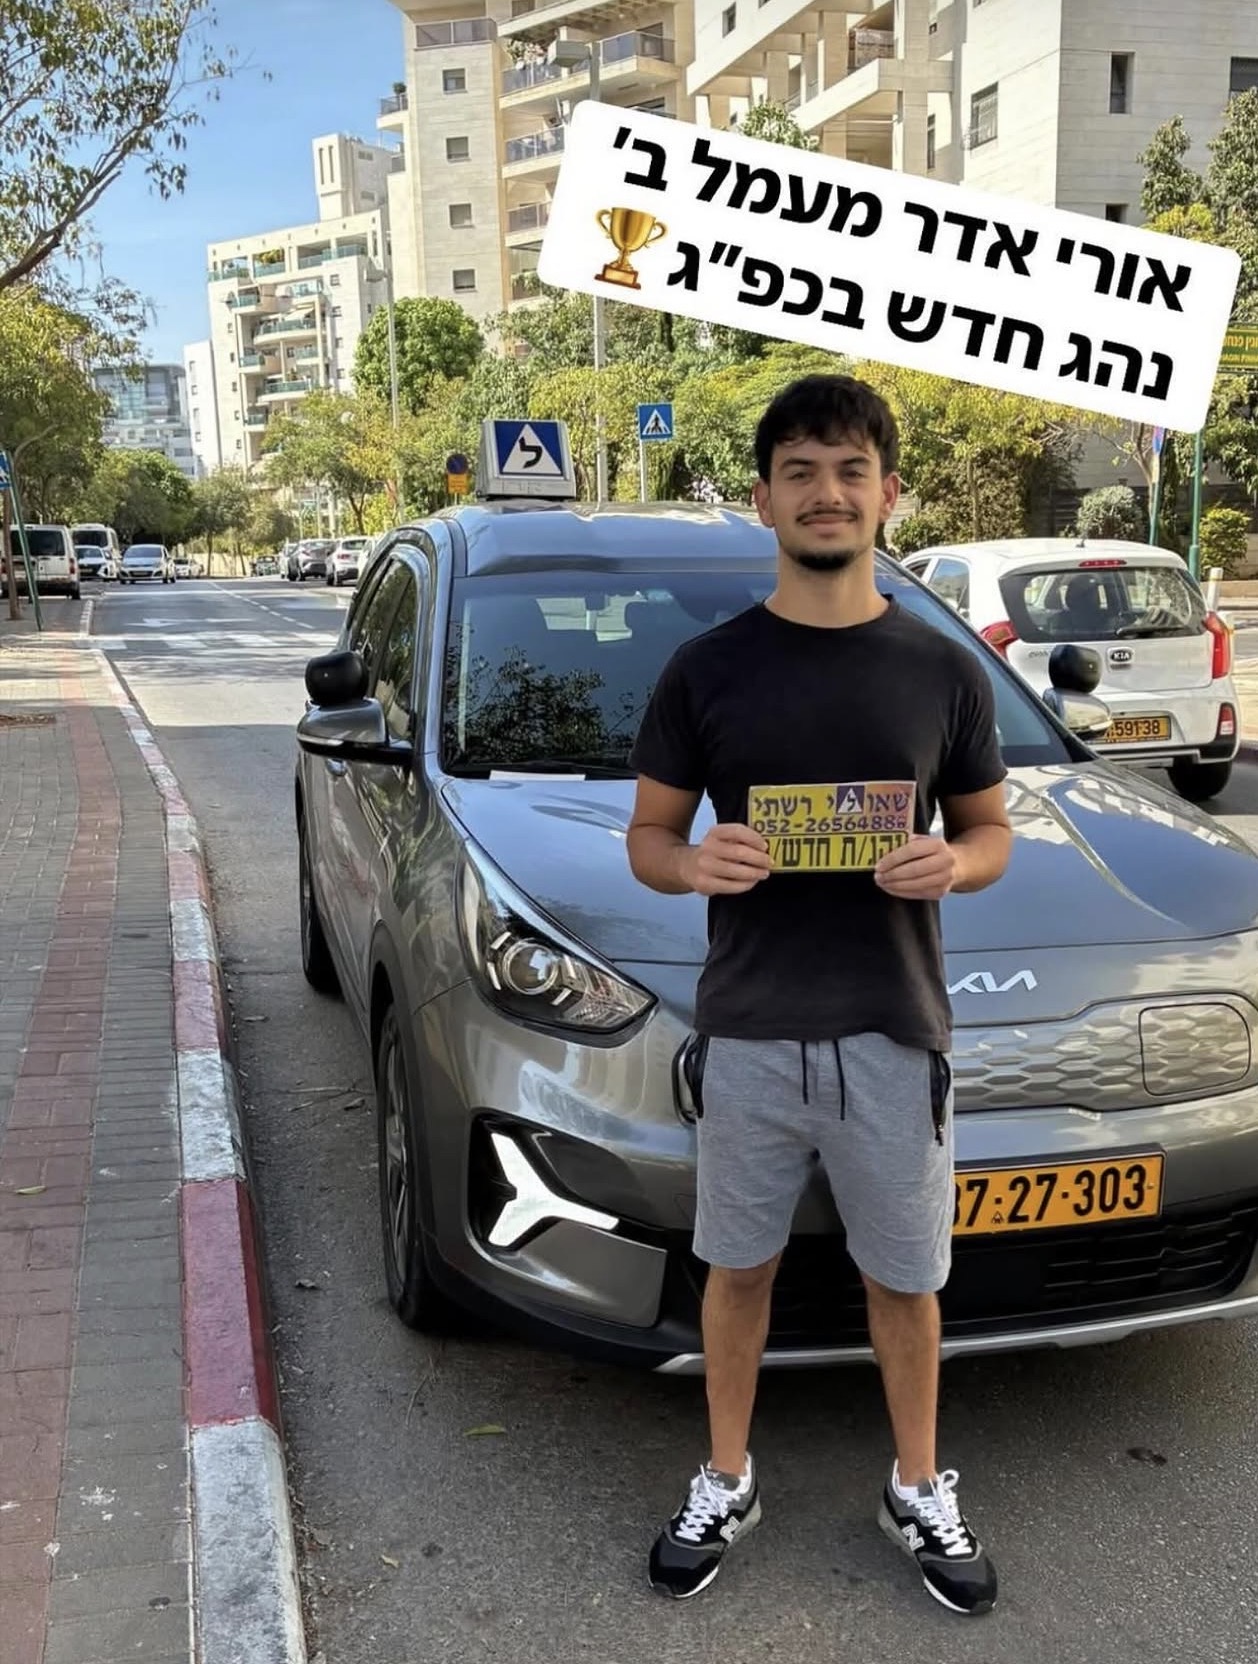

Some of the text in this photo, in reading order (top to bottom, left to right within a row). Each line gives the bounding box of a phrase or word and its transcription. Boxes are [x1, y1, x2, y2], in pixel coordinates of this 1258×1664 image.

[519, 436, 543, 469] ל
[1112, 651, 1131, 661] KIA
[754, 793, 812, 817] רשתי
[766, 836, 830, 867] חדש/
